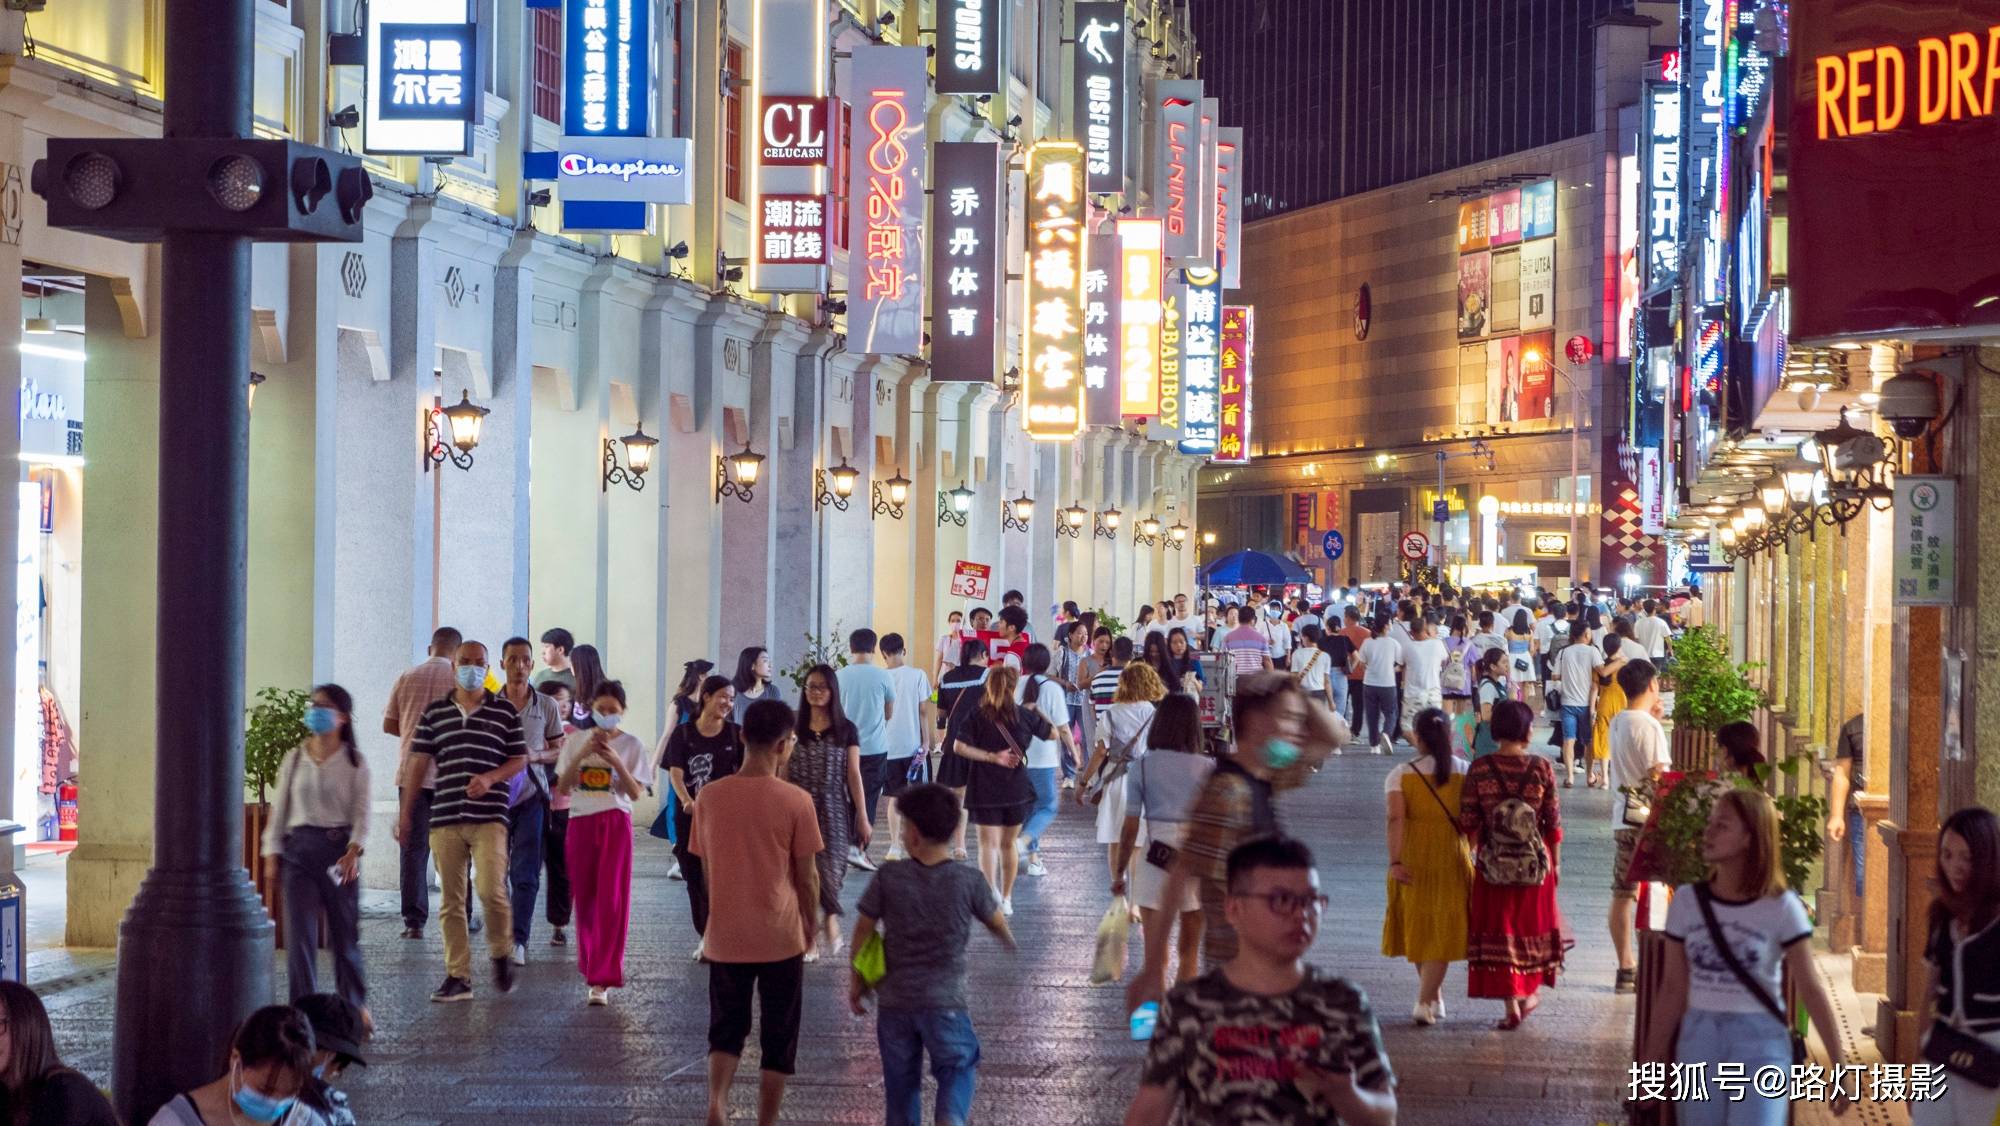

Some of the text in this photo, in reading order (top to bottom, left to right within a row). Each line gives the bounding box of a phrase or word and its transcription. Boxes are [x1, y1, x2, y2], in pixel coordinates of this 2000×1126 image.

[393, 74, 461, 104] 尔克
[1816, 46, 1905, 140] RED
[763, 103, 824, 148] CL
[763, 149, 824, 158] CELUCASN
[1168, 123, 1185, 235] LI-NING
[764, 200, 822, 228] 潮流
[764, 232, 822, 259] 前线
[948, 187, 980, 337] 乔丹体育
[1085, 269, 1108, 389] 乔丹体育
[1160, 330, 1180, 430] BABIBOY
[1221, 346, 1244, 458] 金山首饰
[1911, 515, 1923, 570] 诚信经营
[1927, 535, 1939, 591] 放心消费
